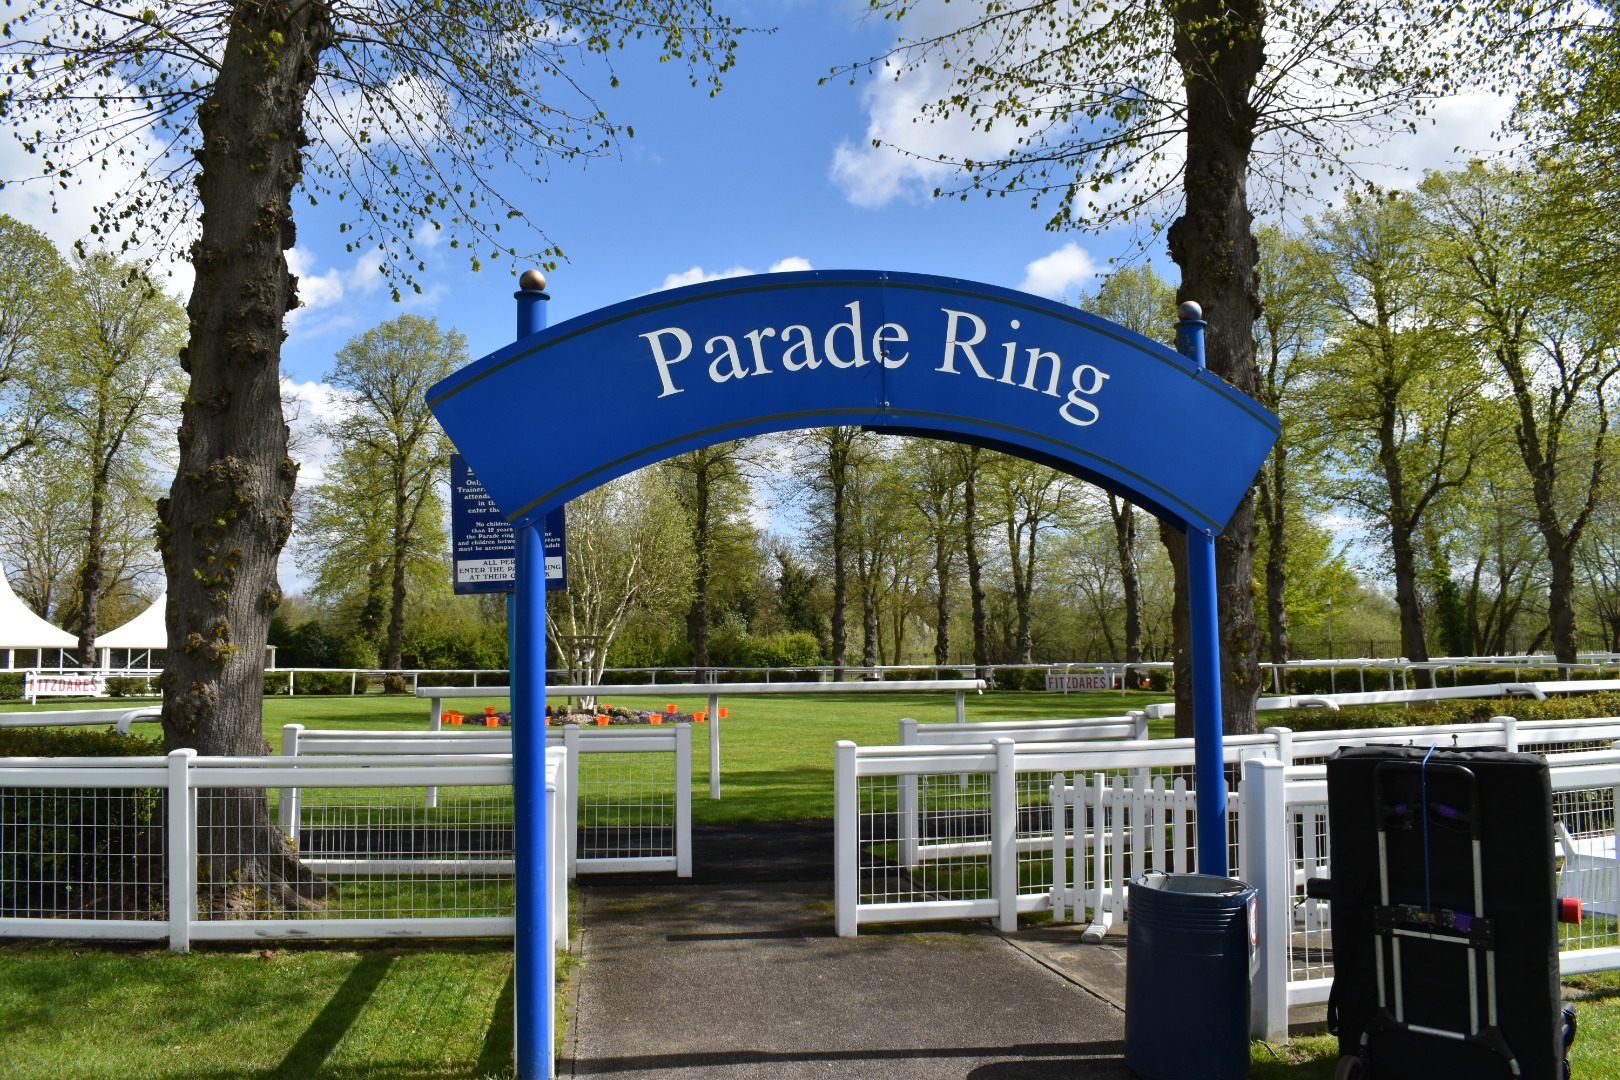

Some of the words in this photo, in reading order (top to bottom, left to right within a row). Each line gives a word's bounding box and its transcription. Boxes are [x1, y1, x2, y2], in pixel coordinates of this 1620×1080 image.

[639, 301, 909, 399] Parade
[935, 308, 1110, 426] Ring
[1048, 677, 1106, 688] FITZDARES
